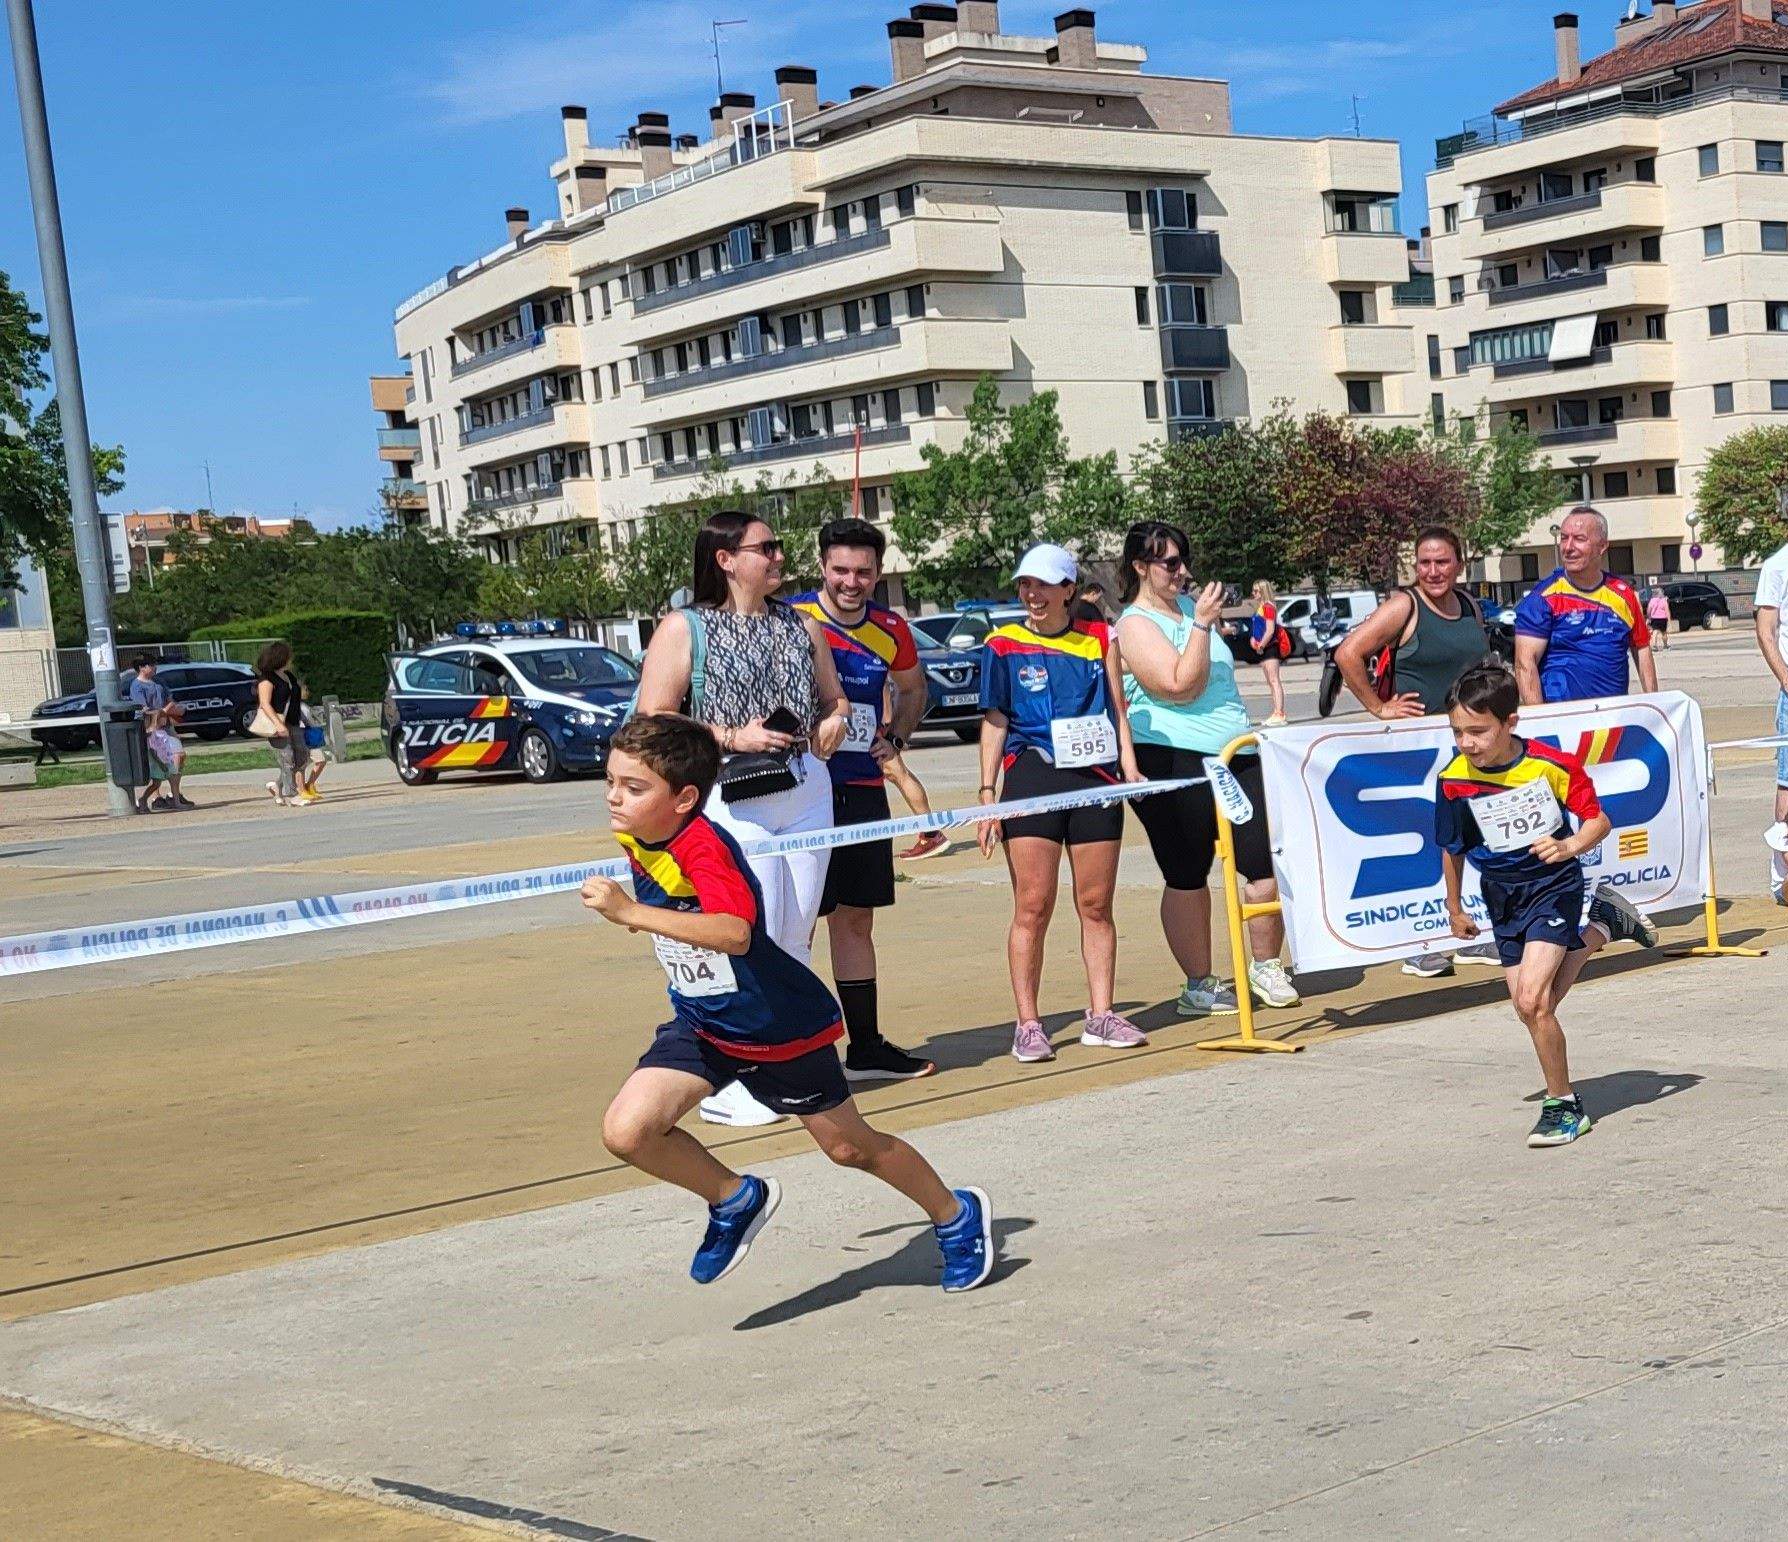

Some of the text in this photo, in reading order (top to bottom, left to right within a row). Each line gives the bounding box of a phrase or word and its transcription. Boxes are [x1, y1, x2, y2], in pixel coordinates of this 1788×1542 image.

[846, 727, 869, 742] 92
[1071, 739, 1107, 758] 595
[1496, 810, 1547, 840] 792
[1599, 864, 1672, 888] POLICIA
[1345, 897, 1448, 929] SINDICAT
[666, 961, 716, 984] 704
